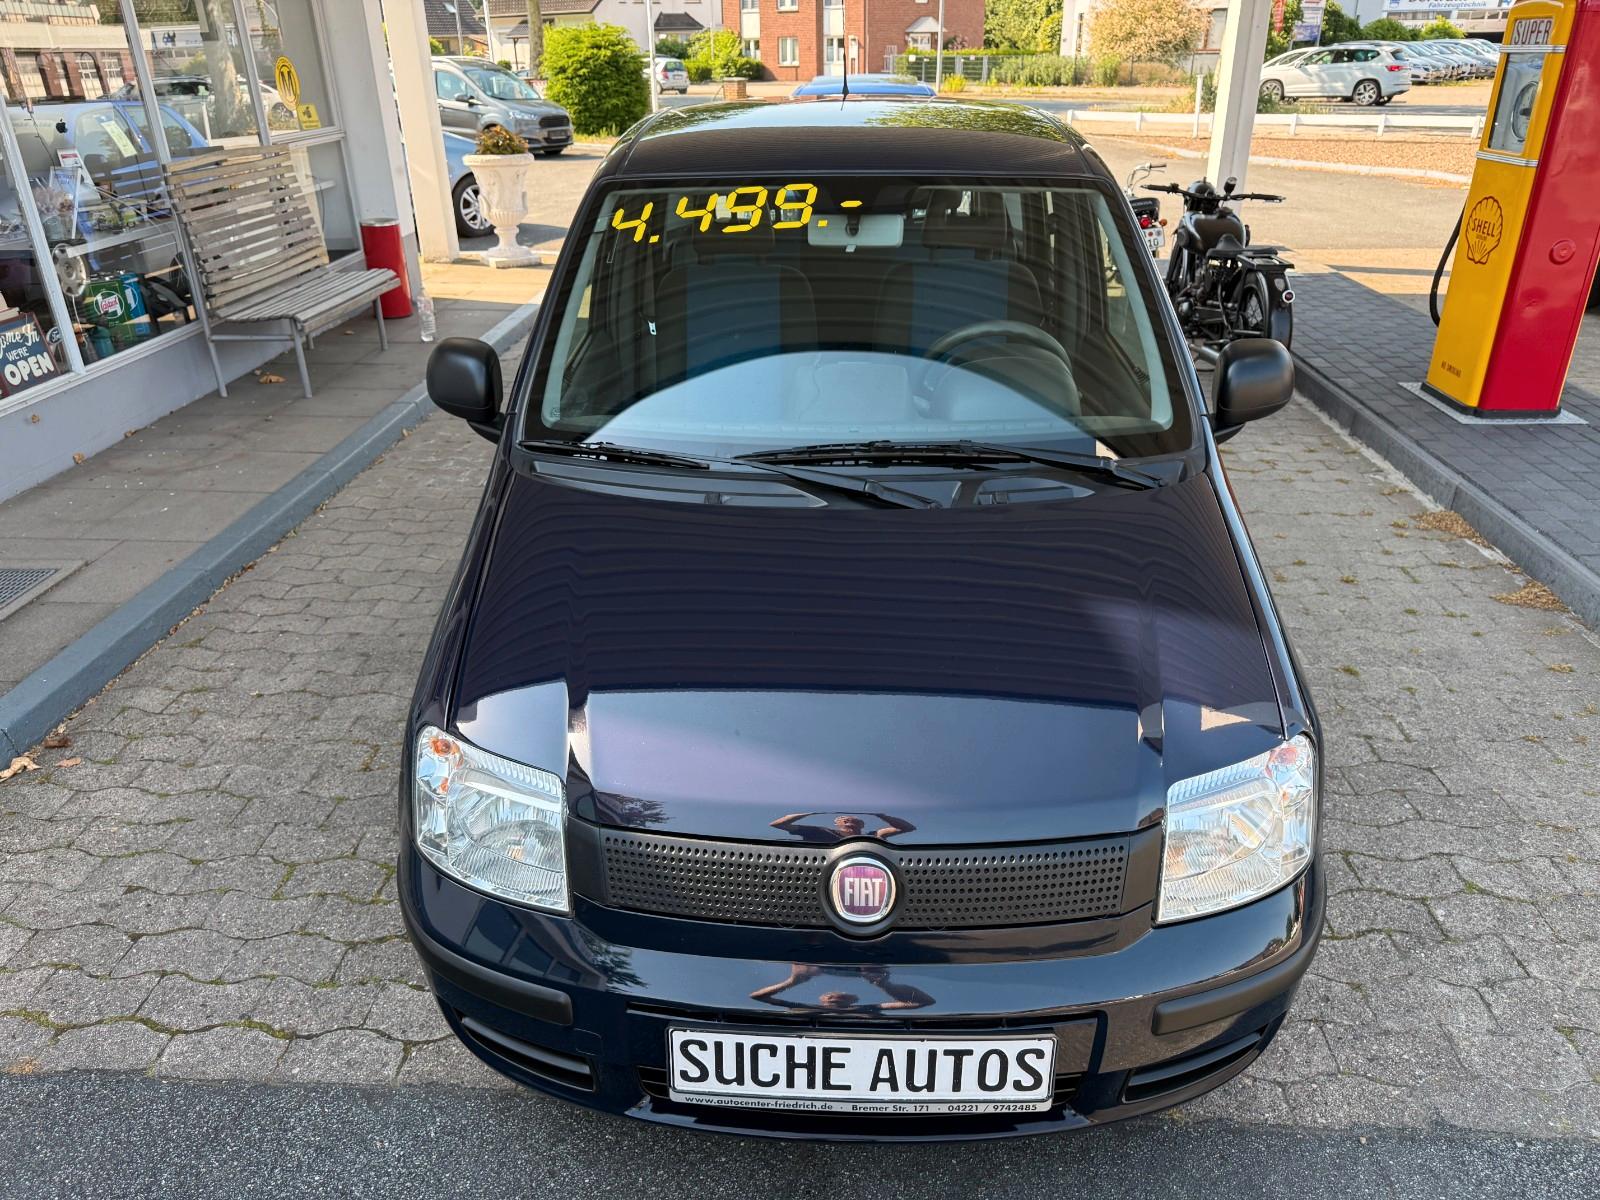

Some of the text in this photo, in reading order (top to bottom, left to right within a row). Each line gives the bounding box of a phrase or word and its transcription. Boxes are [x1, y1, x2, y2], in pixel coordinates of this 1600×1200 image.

[1428, 2, 1487, 10] Fahrzeugtechnik
[1513, 20, 1552, 45] SUPER
[1472, 217, 1496, 238] SHELL
[4, 351, 55, 387] OPEN
[844, 876, 884, 908] FIAT
[678, 1038, 1046, 1093] SUCHE AUTOS
[684, 1096, 833, 1110] www.autocenter-friedrich.de
[851, 1104, 889, 1113] Bremer
[892, 1104, 909, 1113] Str.
[912, 1104, 930, 1113] 171
[946, 1104, 979, 1113] 04221
[992, 1103, 1038, 1112] 9742485
